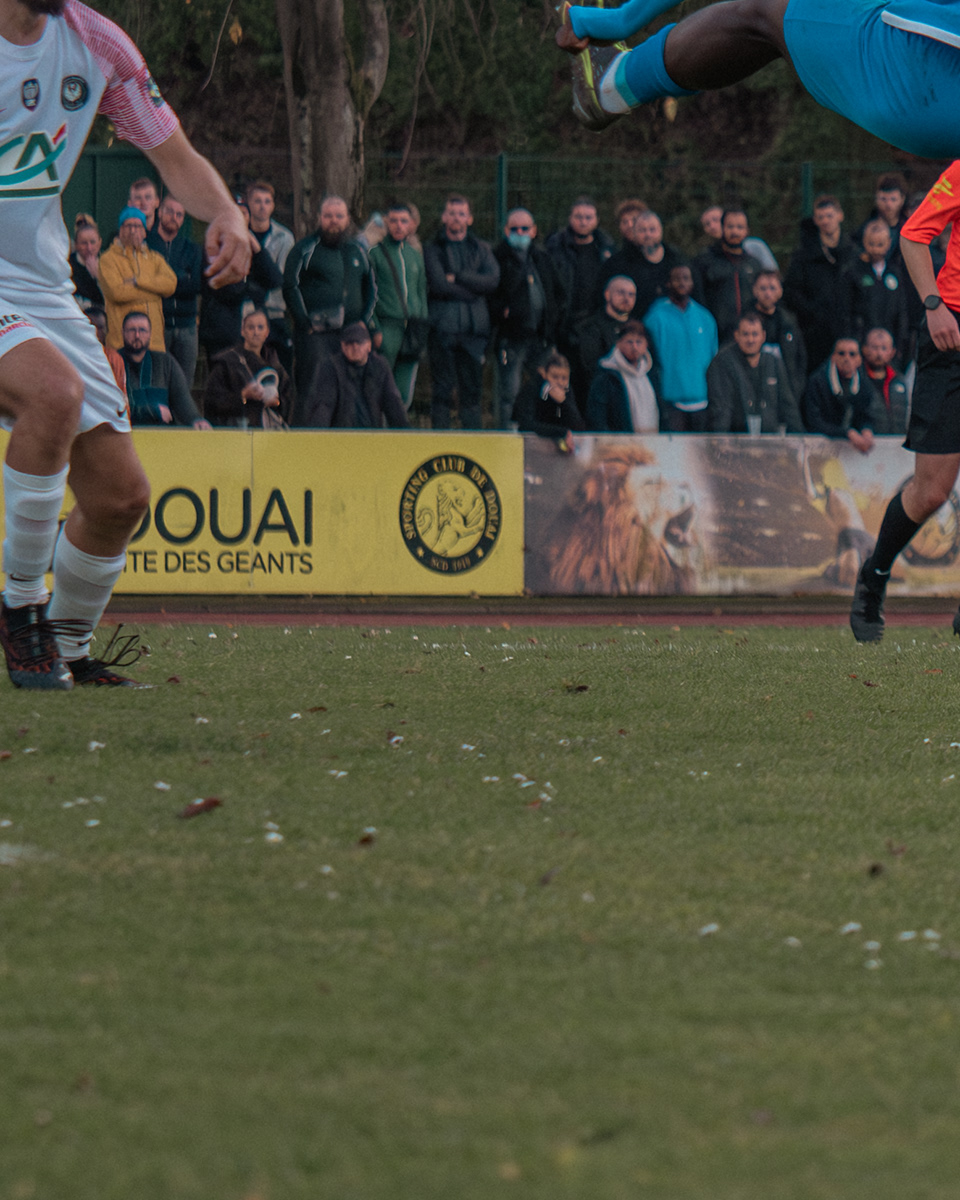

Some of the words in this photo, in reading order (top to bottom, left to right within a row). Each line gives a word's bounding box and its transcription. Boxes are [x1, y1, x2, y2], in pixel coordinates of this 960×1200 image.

[402, 467, 429, 540] SPORTING
[433, 456, 465, 473] CLUB
[469, 465, 488, 488] DE
[484, 490, 499, 540] DOUAI
[164, 551, 211, 574] DES
[217, 551, 313, 575] GEANTS
